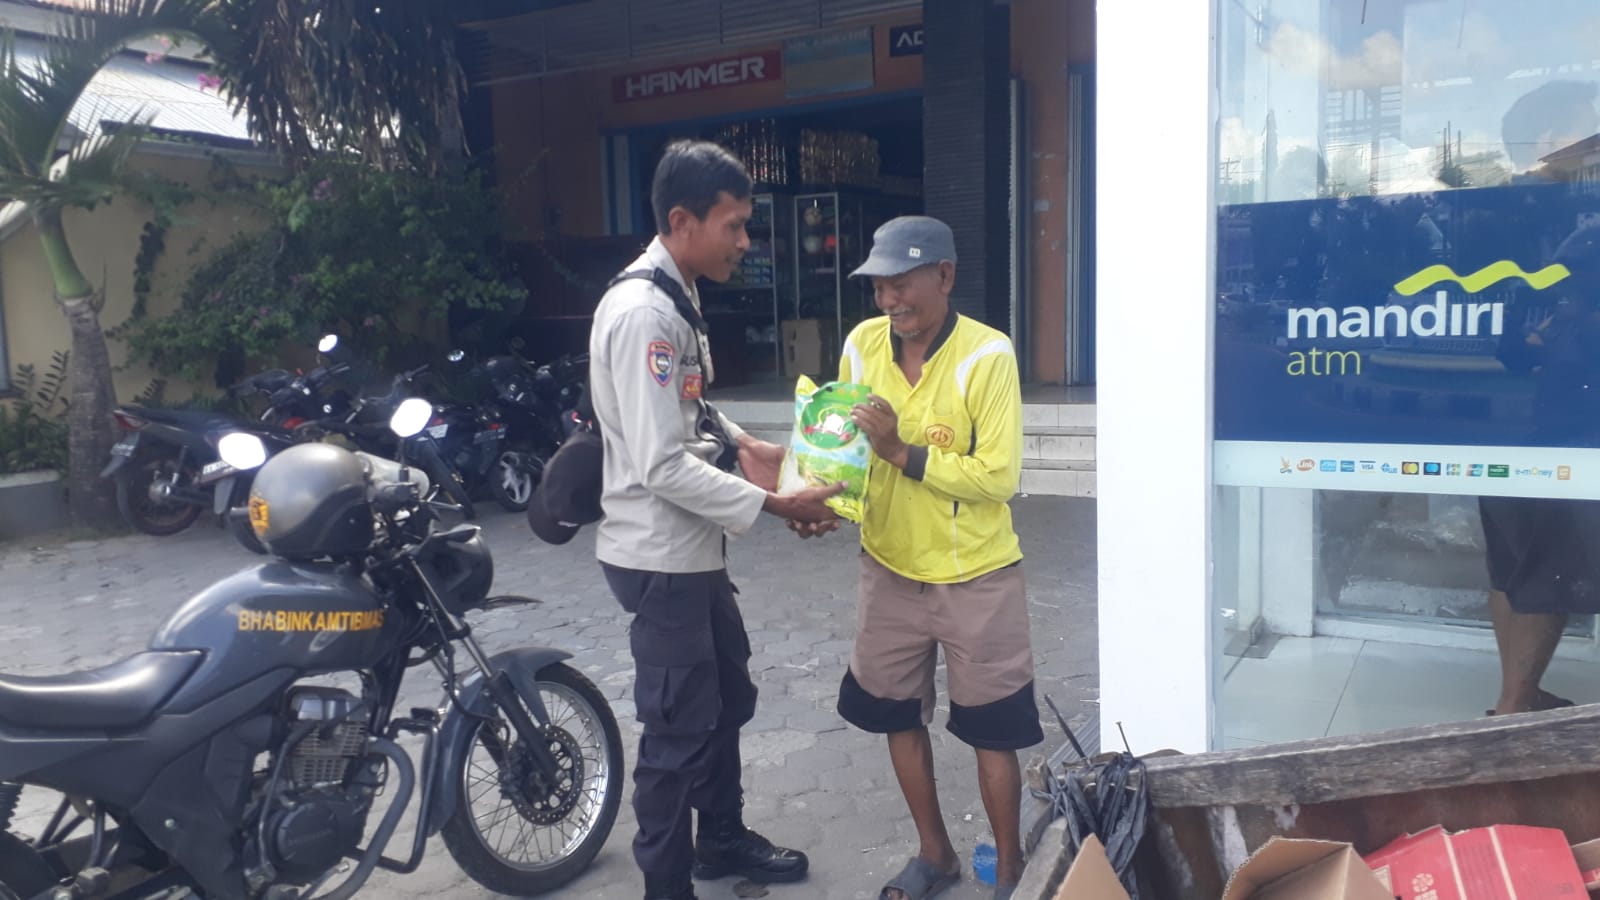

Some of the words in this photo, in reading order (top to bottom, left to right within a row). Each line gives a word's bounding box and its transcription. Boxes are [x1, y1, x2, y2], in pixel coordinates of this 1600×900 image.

[626, 56, 765, 98] HAMMER
[1287, 290, 1504, 339] mandiri
[1287, 347, 1361, 376] atm
[237, 609, 385, 632] BHABINKAMTIBMAS
